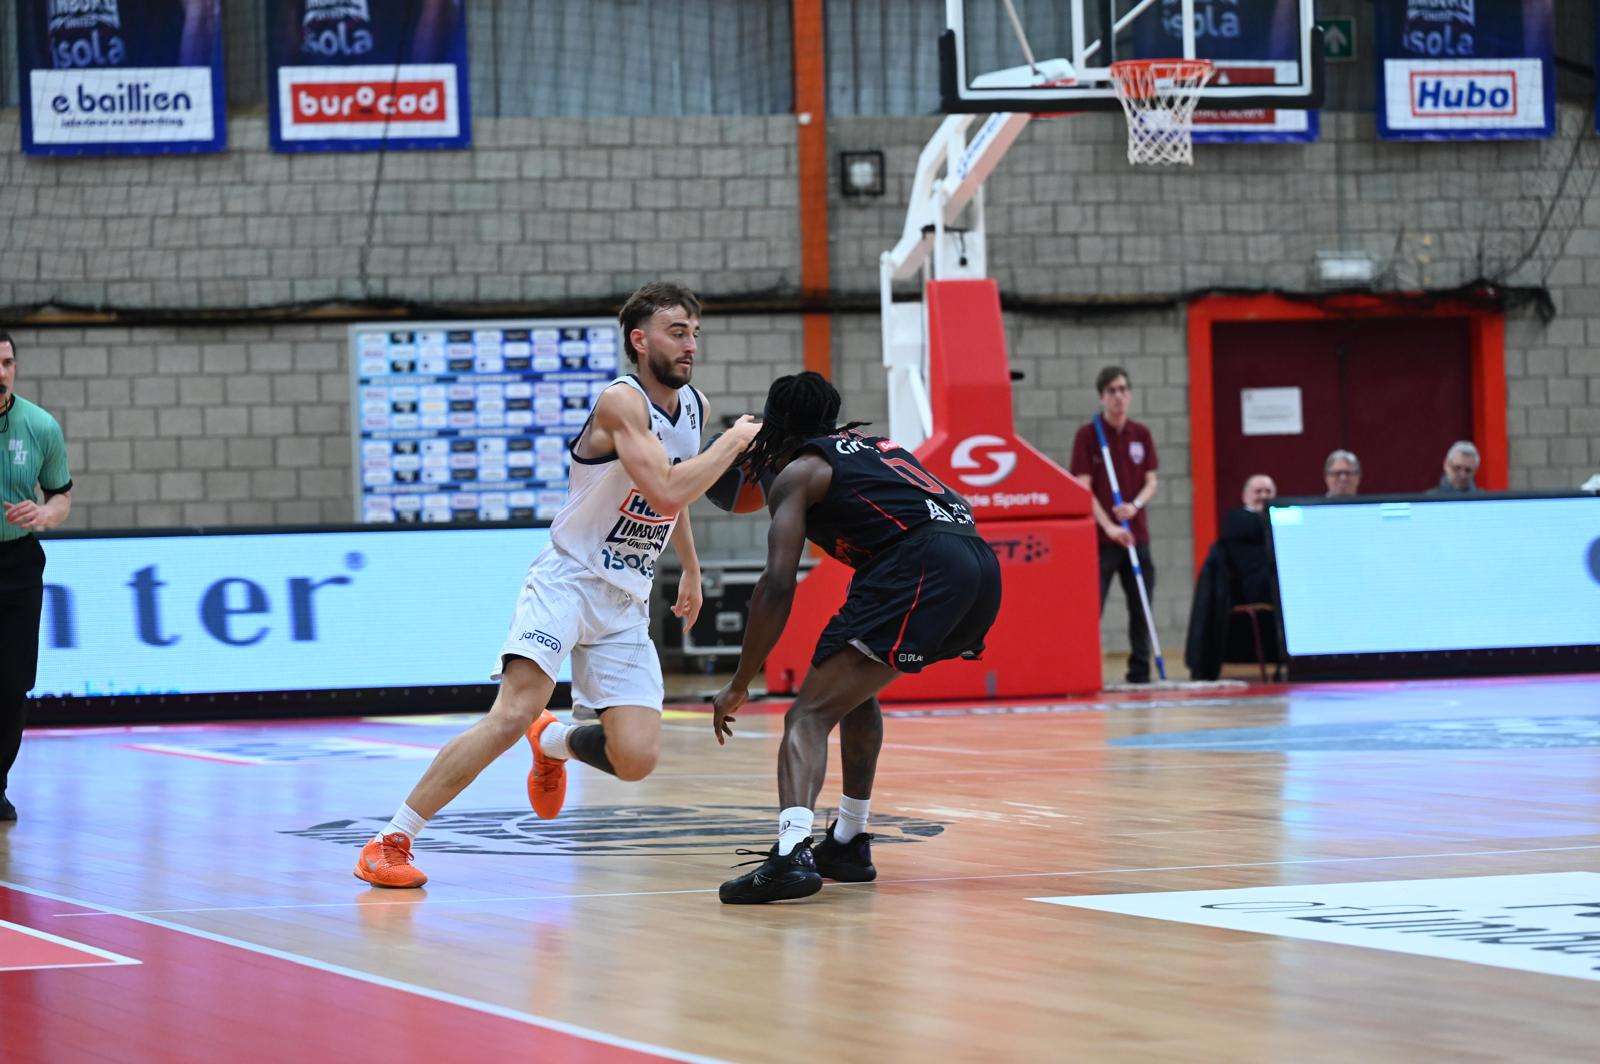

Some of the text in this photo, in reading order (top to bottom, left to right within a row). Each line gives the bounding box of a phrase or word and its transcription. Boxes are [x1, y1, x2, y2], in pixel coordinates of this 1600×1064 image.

[77, 83, 191, 113] baillien
[299, 86, 439, 116] burocad
[1417, 80, 1510, 109] Hubo
[992, 492, 1050, 509] Sports
